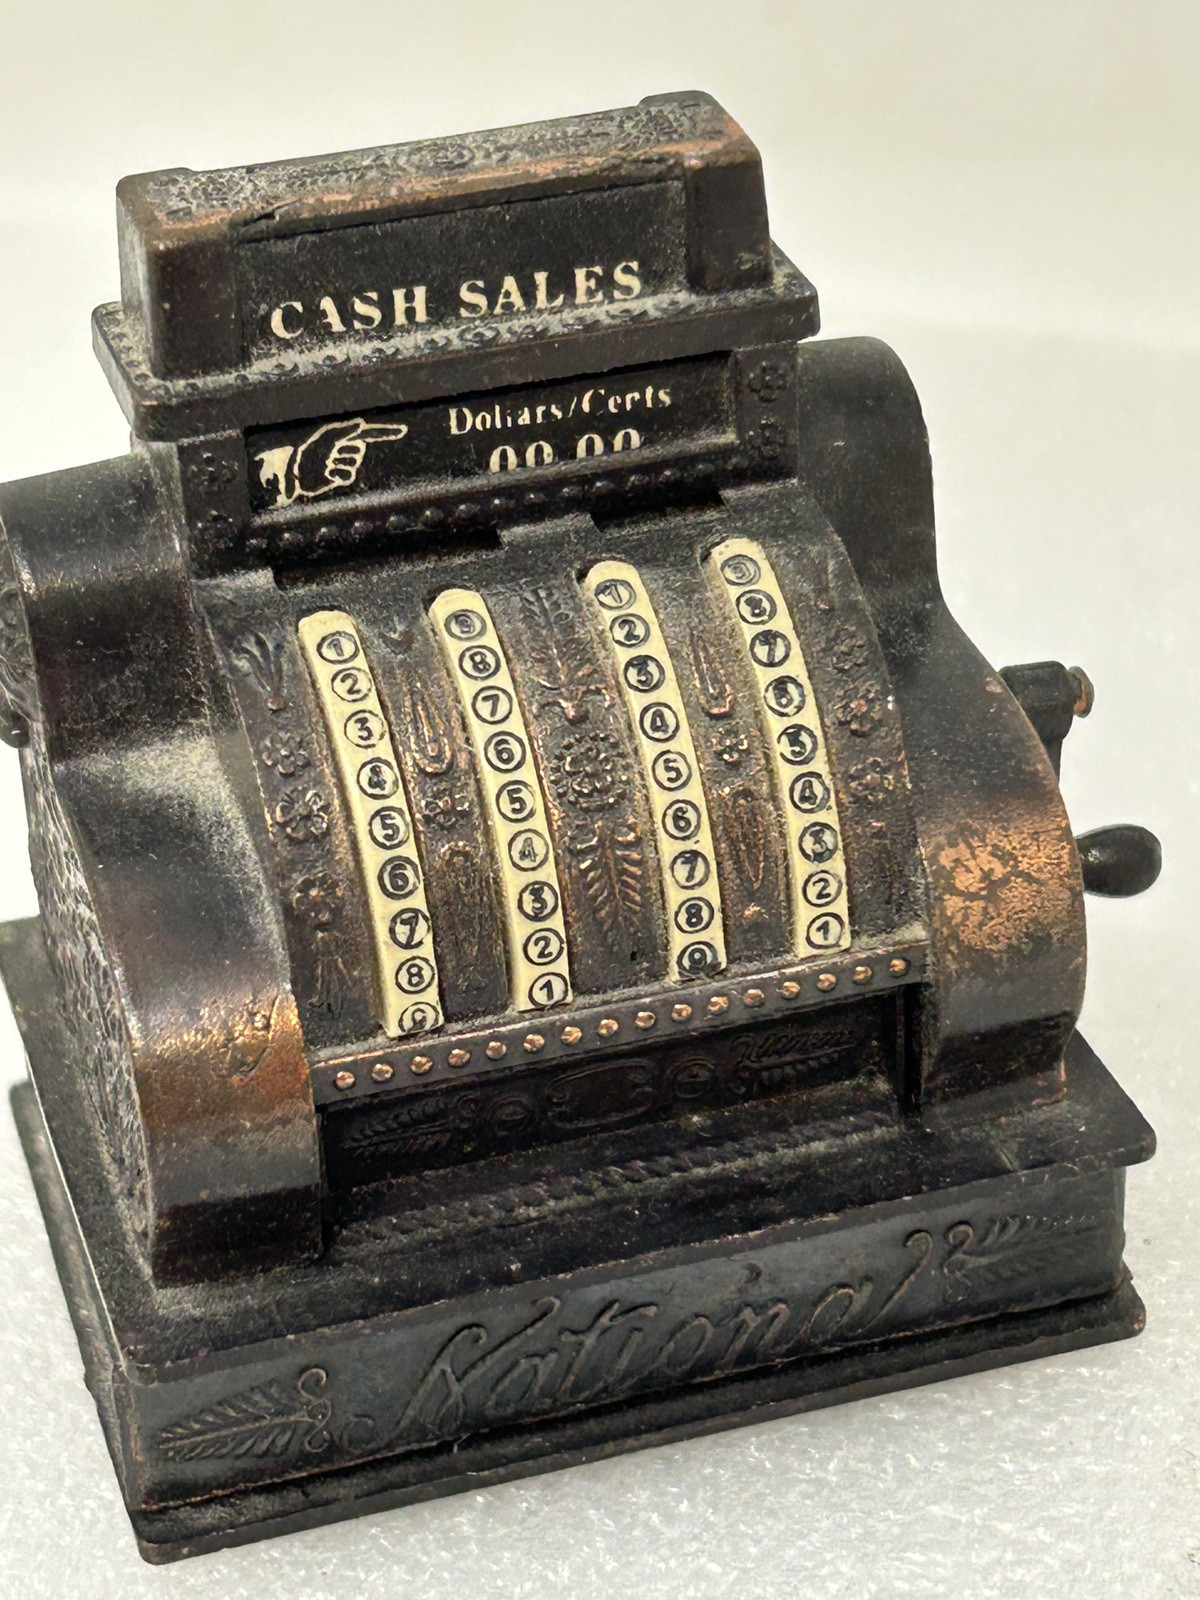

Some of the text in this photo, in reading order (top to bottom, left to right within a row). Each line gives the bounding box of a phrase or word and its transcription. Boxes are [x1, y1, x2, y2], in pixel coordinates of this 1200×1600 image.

[270, 260, 643, 340] CASH SALES
[340, 1228, 932, 1452] National
